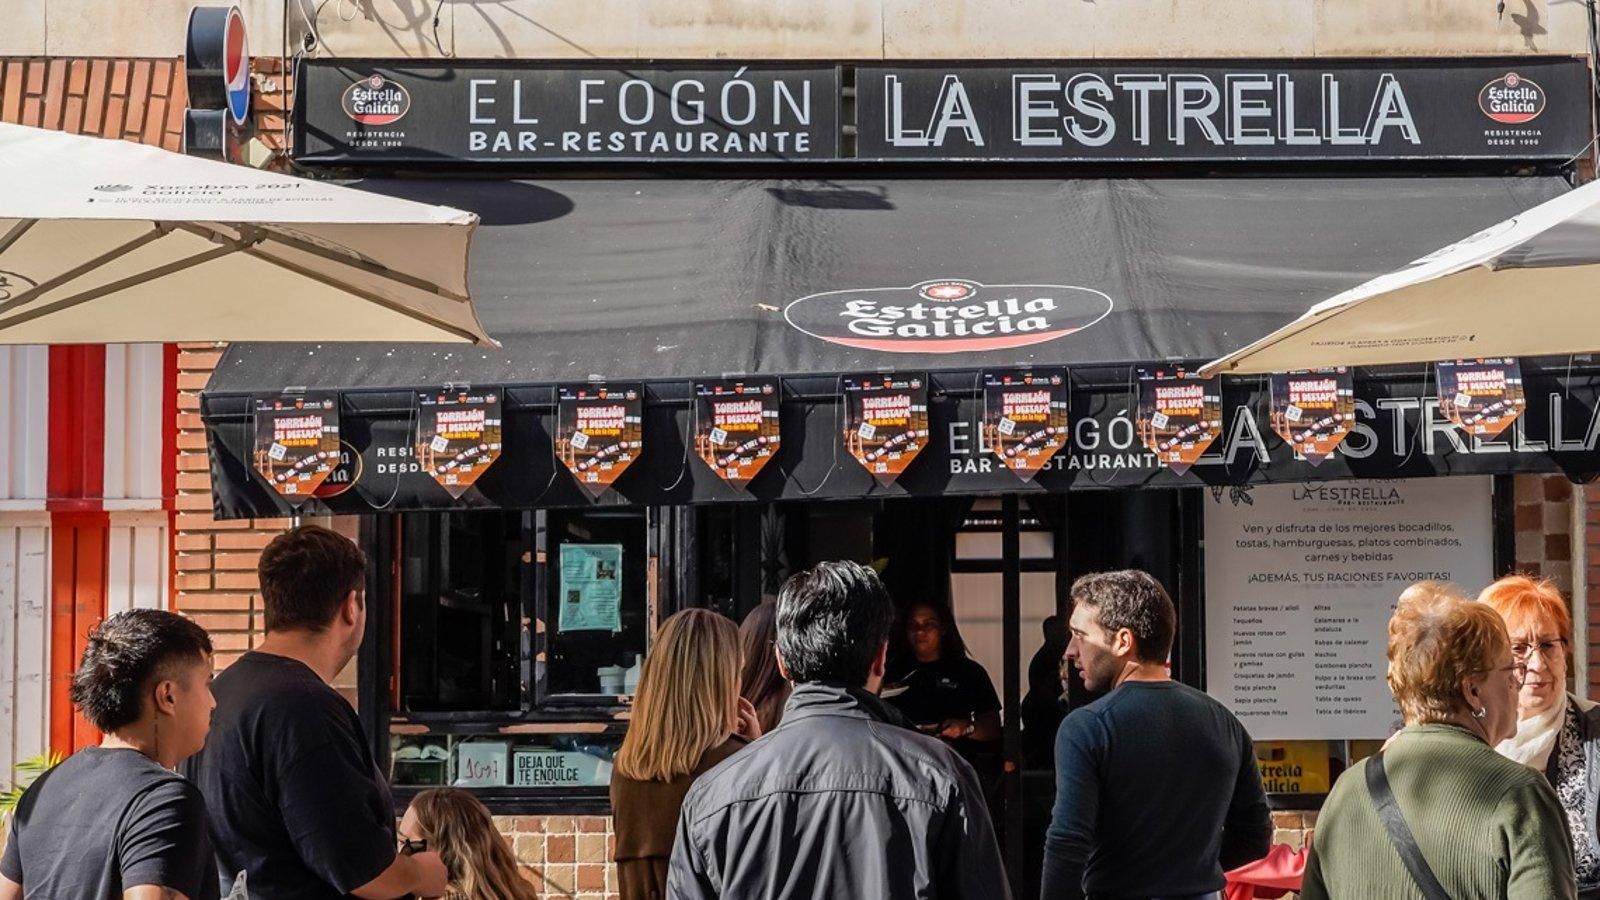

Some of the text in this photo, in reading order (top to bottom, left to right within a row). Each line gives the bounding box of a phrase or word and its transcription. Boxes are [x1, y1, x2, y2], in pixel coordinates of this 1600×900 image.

[351, 88, 402, 101] Estrella
[469, 66, 811, 126] EL FOGÓN
[1488, 87, 1537, 100] Estrella
[353, 101, 400, 114] Galicia
[885, 73, 1422, 147] LA ESTRELLA
[1490, 100, 1535, 112] Galicia
[469, 131, 811, 153] BAR-RESTAURANTE
[839, 298, 1058, 320] Estrella
[848, 314, 1051, 338] Galicia
[1456, 369, 1504, 382] TORREJÓN
[1155, 384, 1204, 399] TORREJÓN
[1288, 379, 1337, 392] TORREJÓN
[1457, 381, 1506, 391] SE DESTAPA
[862, 394, 911, 409] TORREJÓN
[1002, 390, 1051, 404] TORREJÓN
[1156, 398, 1204, 409] SE DESTAPA
[1289, 392, 1337, 403] SE DESTAPA
[576, 405, 625, 419] TORREJÓN
[714, 400, 762, 414] TORREJÓN
[1003, 403, 1051, 415] SE DESTAPA
[436, 408, 485, 423] TORREJÓN
[714, 413, 763, 425] SE DESTAPA
[863, 408, 911, 420] SE DESTAPA
[274, 415, 322, 430] TORREJÓN
[436, 421, 485, 433] SE DESTAPA
[577, 418, 625, 429] SE DESTAPA
[1293, 392, 1600, 461] STRLL
[274, 428, 323, 440] SE DESTAPA
[949, 421, 994, 454] EL
[1292, 487, 1400, 500] LA ESTRELLA
[1243, 522, 1455, 535] Ven y disfruta de los mejores bocadillos,
[1235, 537, 1462, 549] tostas, hamburguesas, platos combinados,
[1304, 552, 1394, 563] carnes y bebidas
[1248, 571, 1451, 584] ¡ADEMÁS, TUS RACIONES FAVORITAS!
[1276, 672, 1294, 680] jamón
[519, 755, 565, 769] DEJA QUE
[519, 768, 578, 781] TE ENDULCE
[1261, 764, 1302, 778] trella
